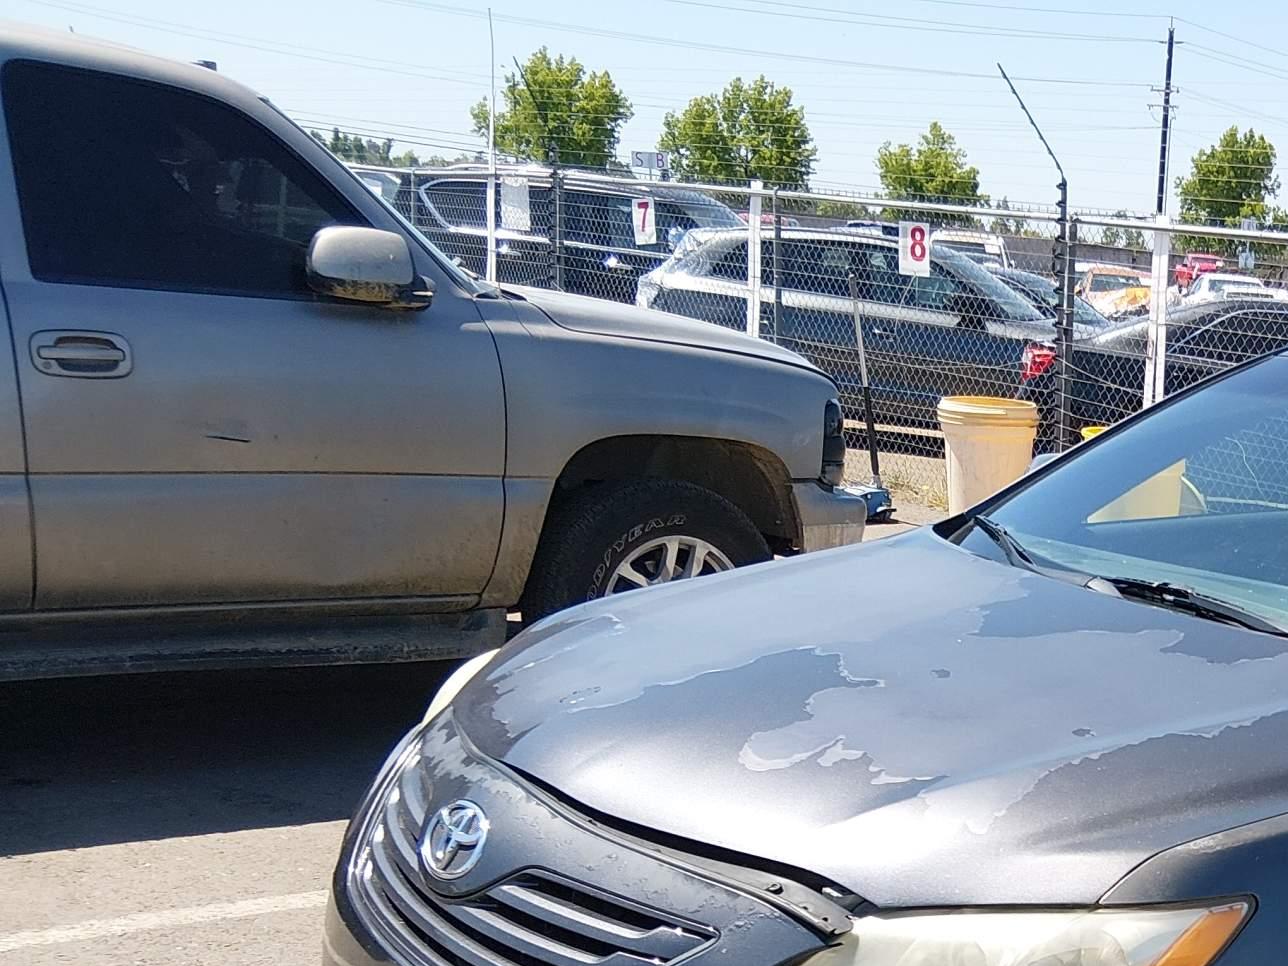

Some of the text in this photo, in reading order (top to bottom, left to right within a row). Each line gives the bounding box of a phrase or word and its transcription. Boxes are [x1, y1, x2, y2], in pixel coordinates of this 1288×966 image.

[635, 152, 665, 169] S B
[637, 201, 649, 232] 7
[910, 225, 926, 262] 8
[587, 514, 687, 600] OODYEAR
